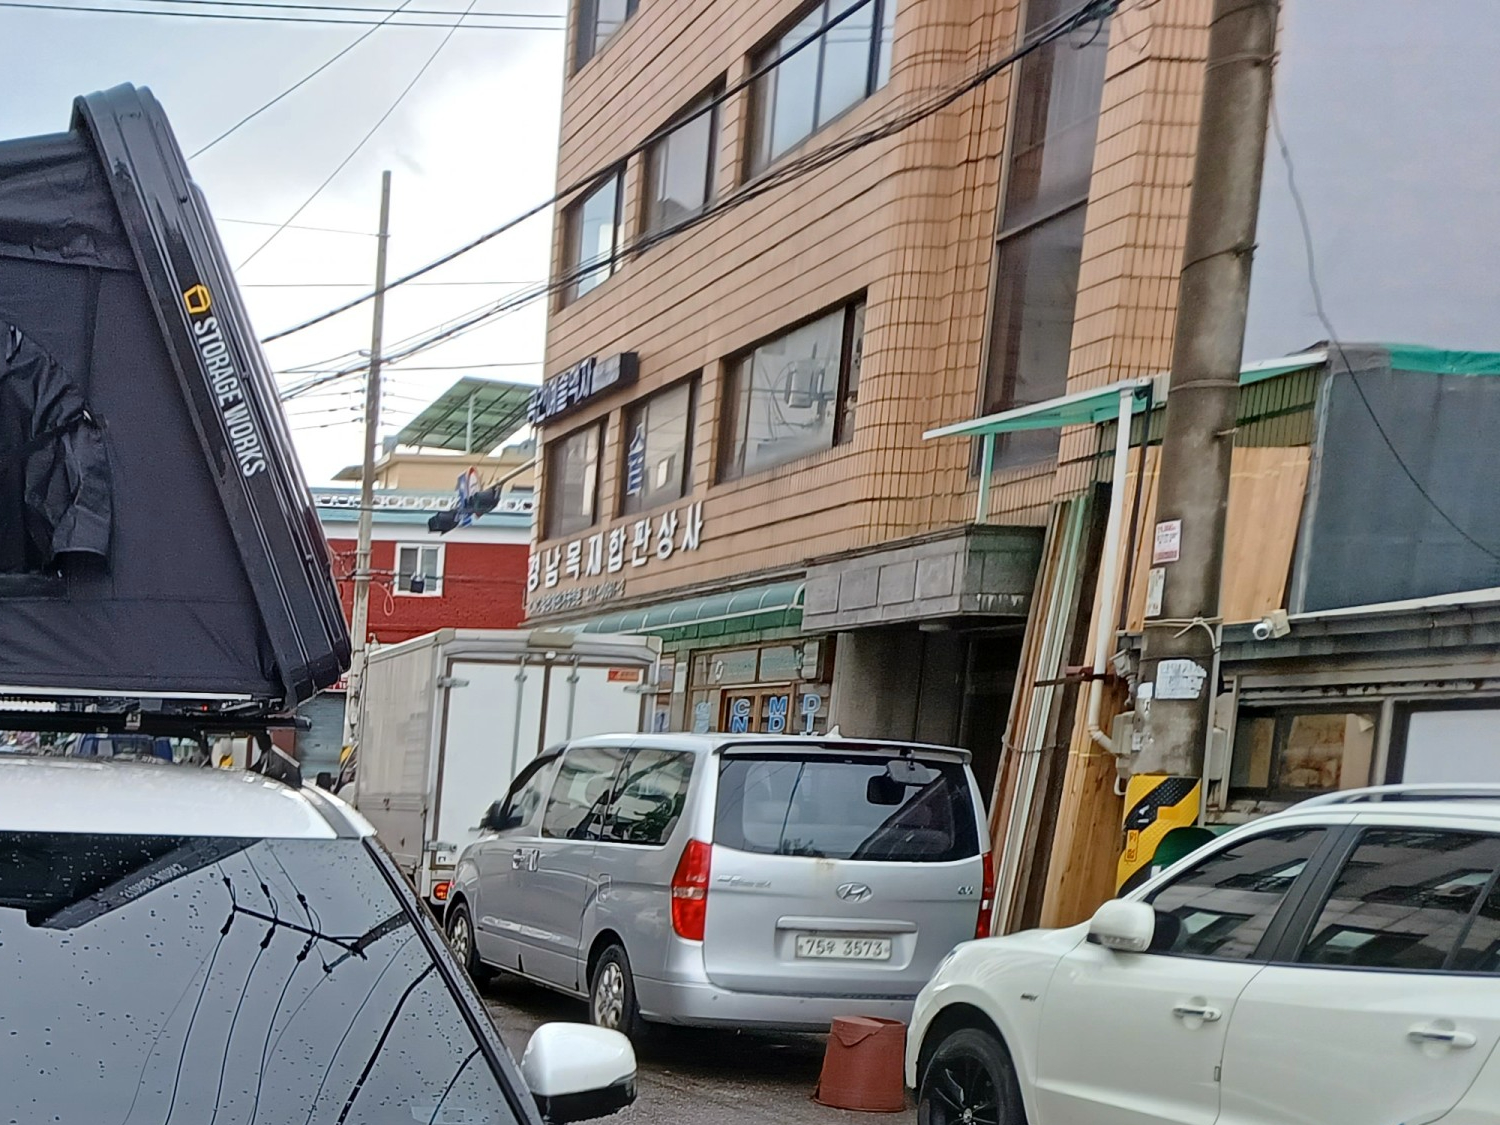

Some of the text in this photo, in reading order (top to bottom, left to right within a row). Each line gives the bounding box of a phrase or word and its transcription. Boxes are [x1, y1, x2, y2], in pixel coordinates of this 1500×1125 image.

[194, 316, 267, 477] STORAGE WORKS
[527, 500, 703, 593] 경남목재합판상사
[842, 940, 883, 957] 3573
